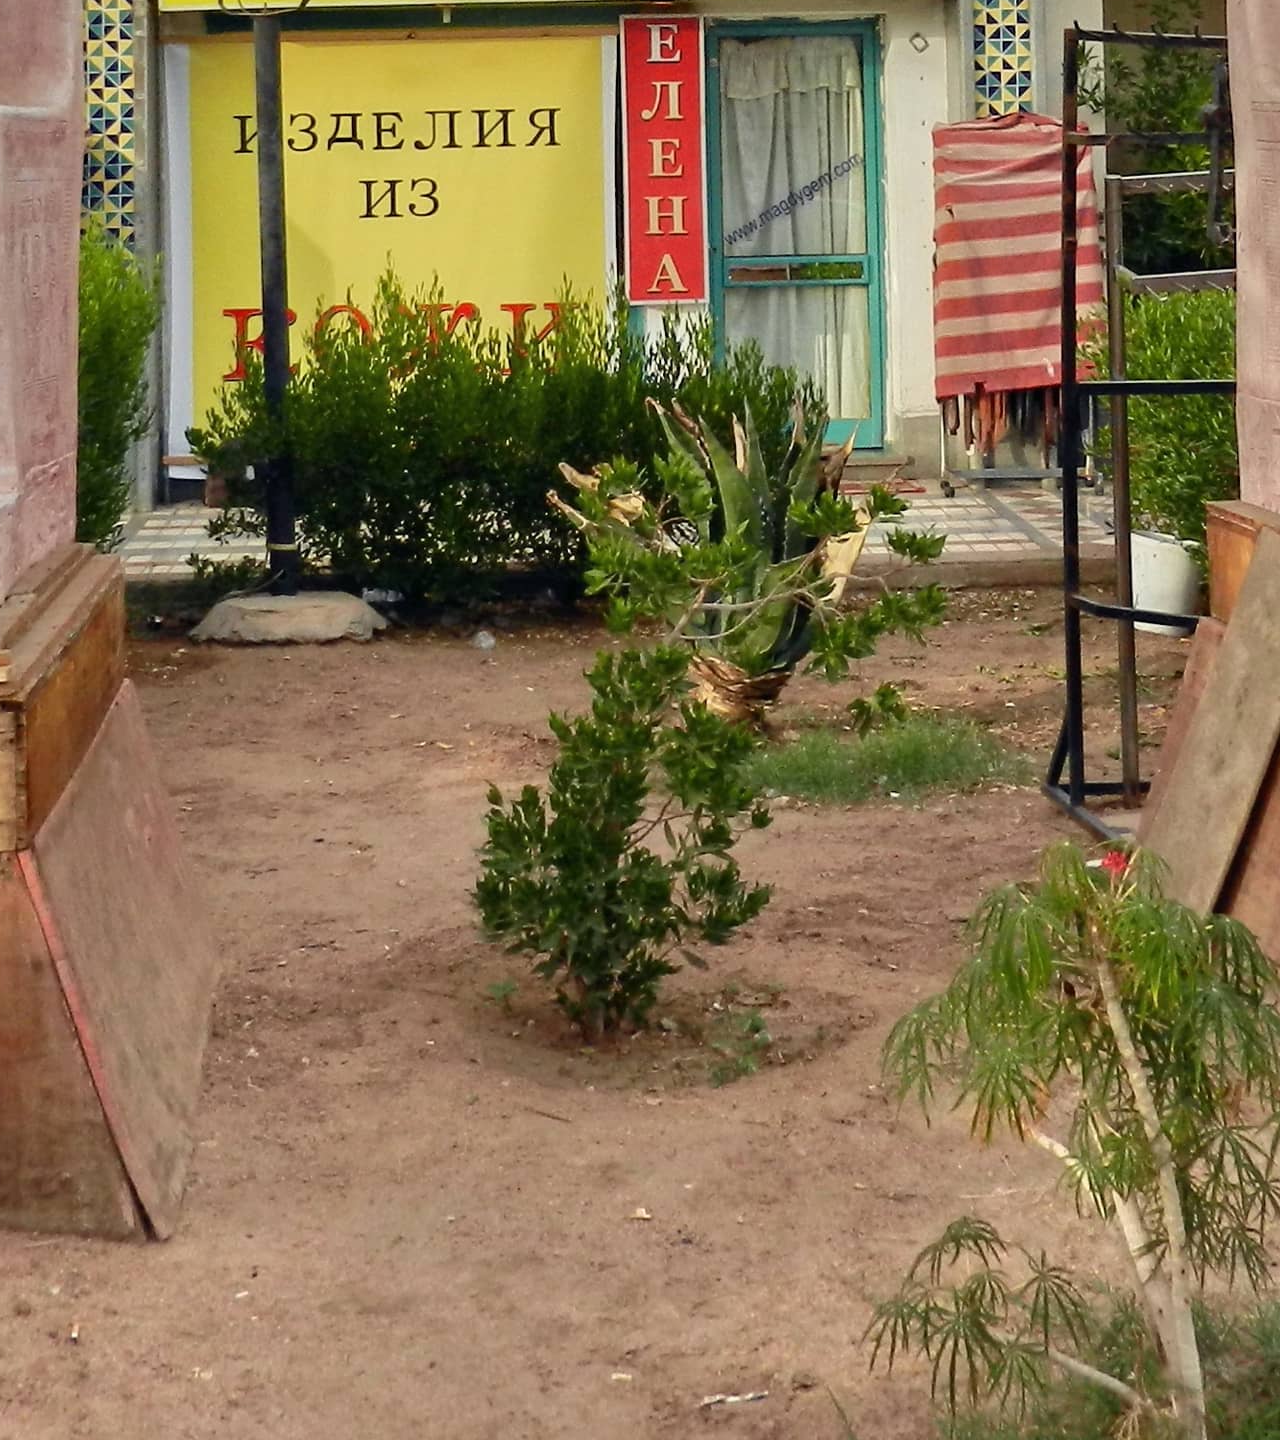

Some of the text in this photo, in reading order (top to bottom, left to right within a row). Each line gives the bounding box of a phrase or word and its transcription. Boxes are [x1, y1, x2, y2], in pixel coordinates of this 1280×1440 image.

[358, 178, 441, 220] ИЗ
[641, 22, 690, 294] ЕЛЕНА
[724, 152, 865, 246] www.magdygem.com
